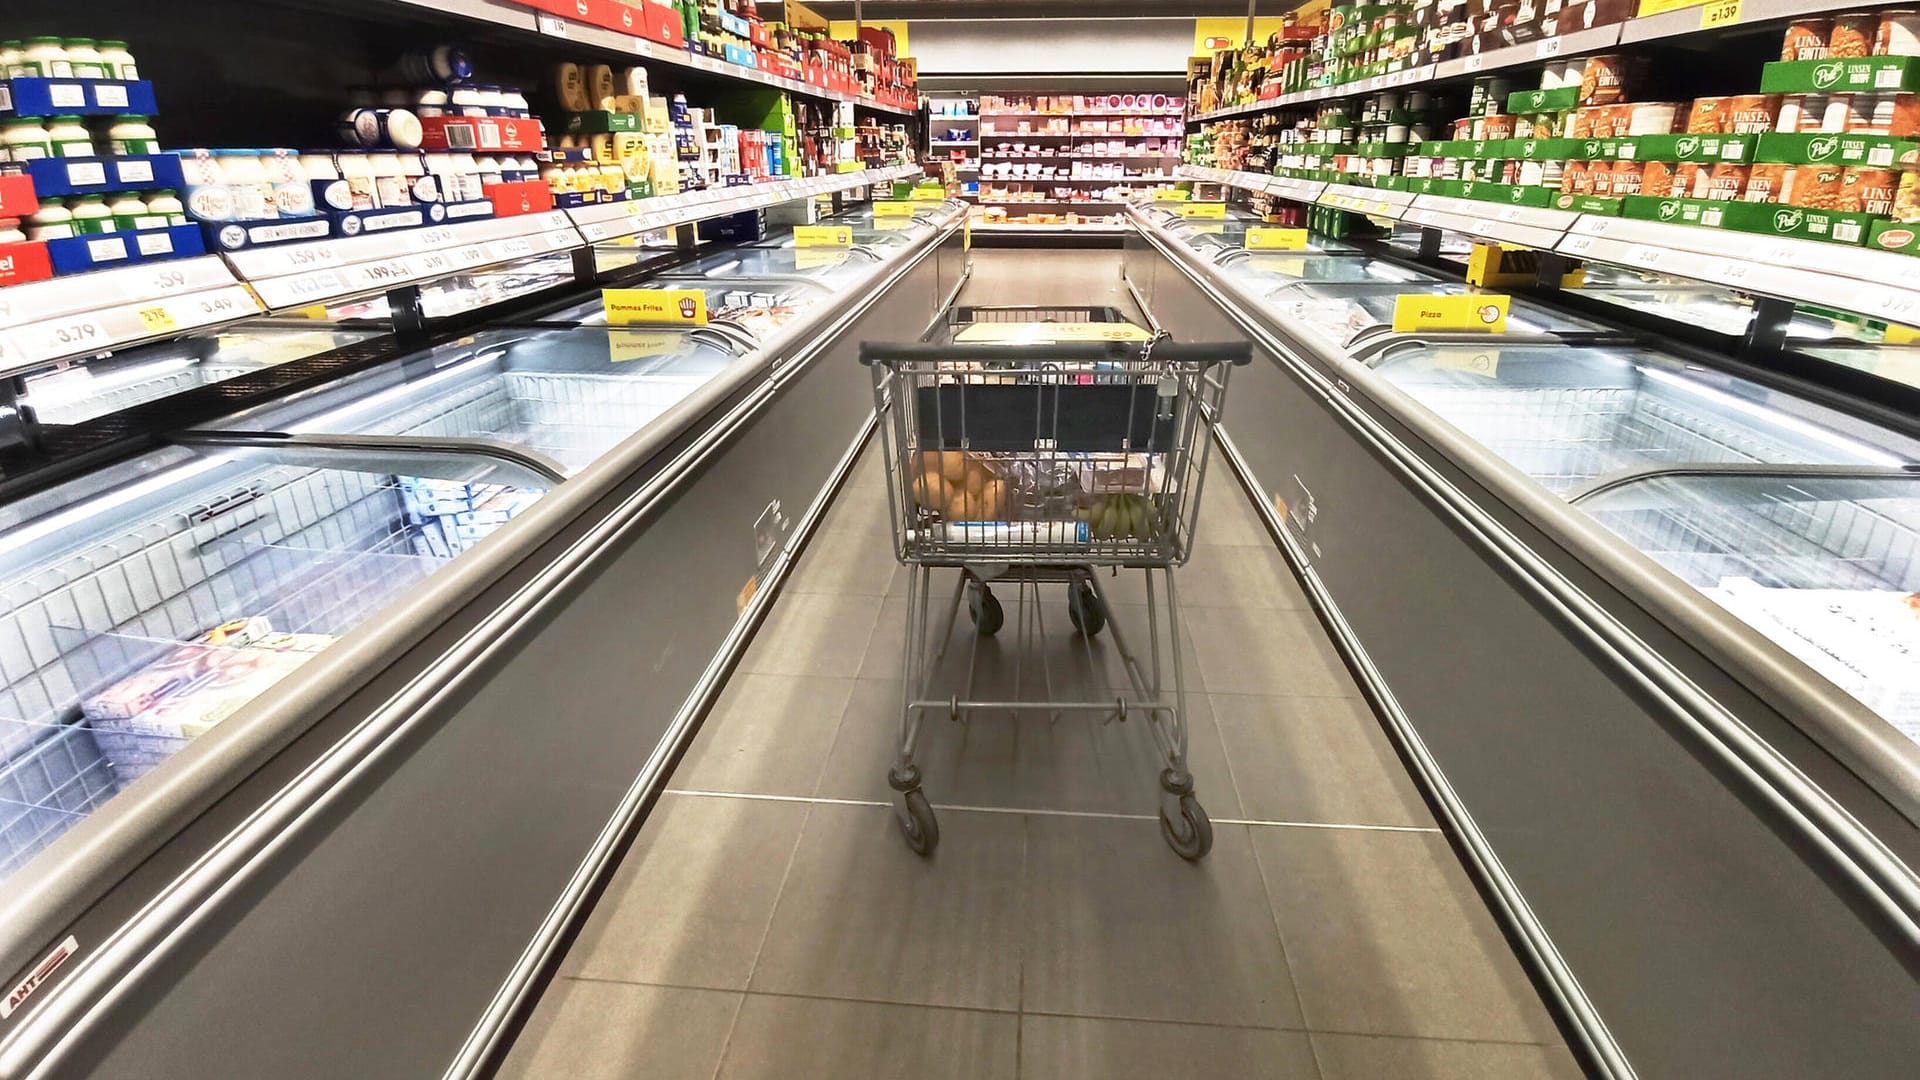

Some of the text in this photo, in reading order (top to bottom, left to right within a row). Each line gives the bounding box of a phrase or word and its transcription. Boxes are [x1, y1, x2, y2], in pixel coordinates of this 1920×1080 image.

[1795, 35, 1825, 48] LINS
[610, 303, 663, 312] Pommes Frites
[1420, 310, 1442, 318] Pizza
[57, 323, 96, 343] 3.79
[10, 975, 36, 1010] AHT
